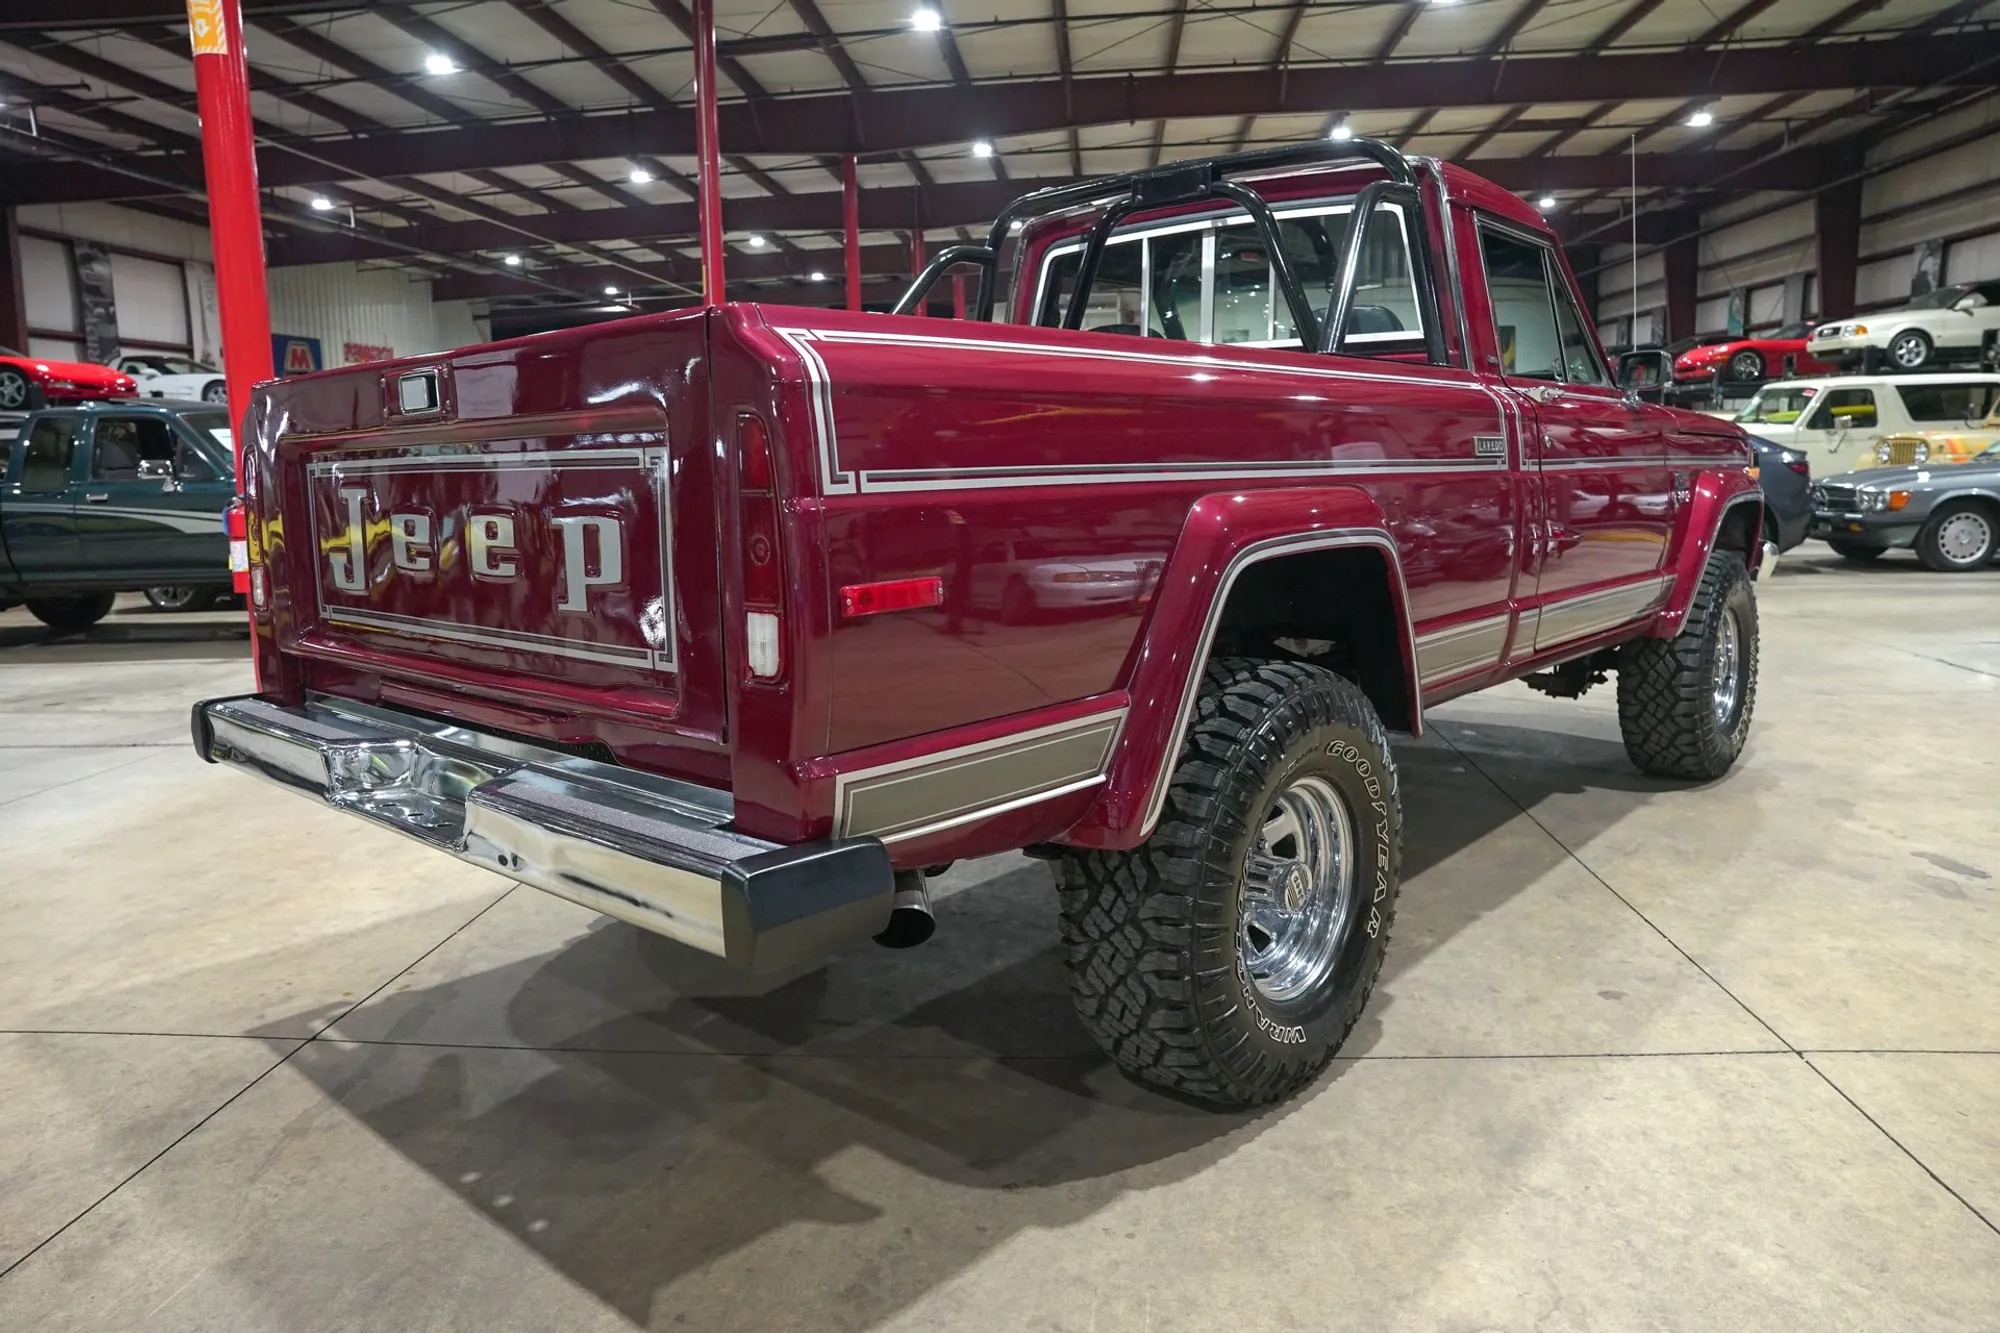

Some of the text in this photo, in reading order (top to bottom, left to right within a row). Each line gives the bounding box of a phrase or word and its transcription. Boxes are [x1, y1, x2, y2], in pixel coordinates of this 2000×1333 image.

[1478, 440, 1503, 451] LAREDO
[329, 486, 623, 613] Jeep
[1326, 739, 1390, 939] GOODYEAR
